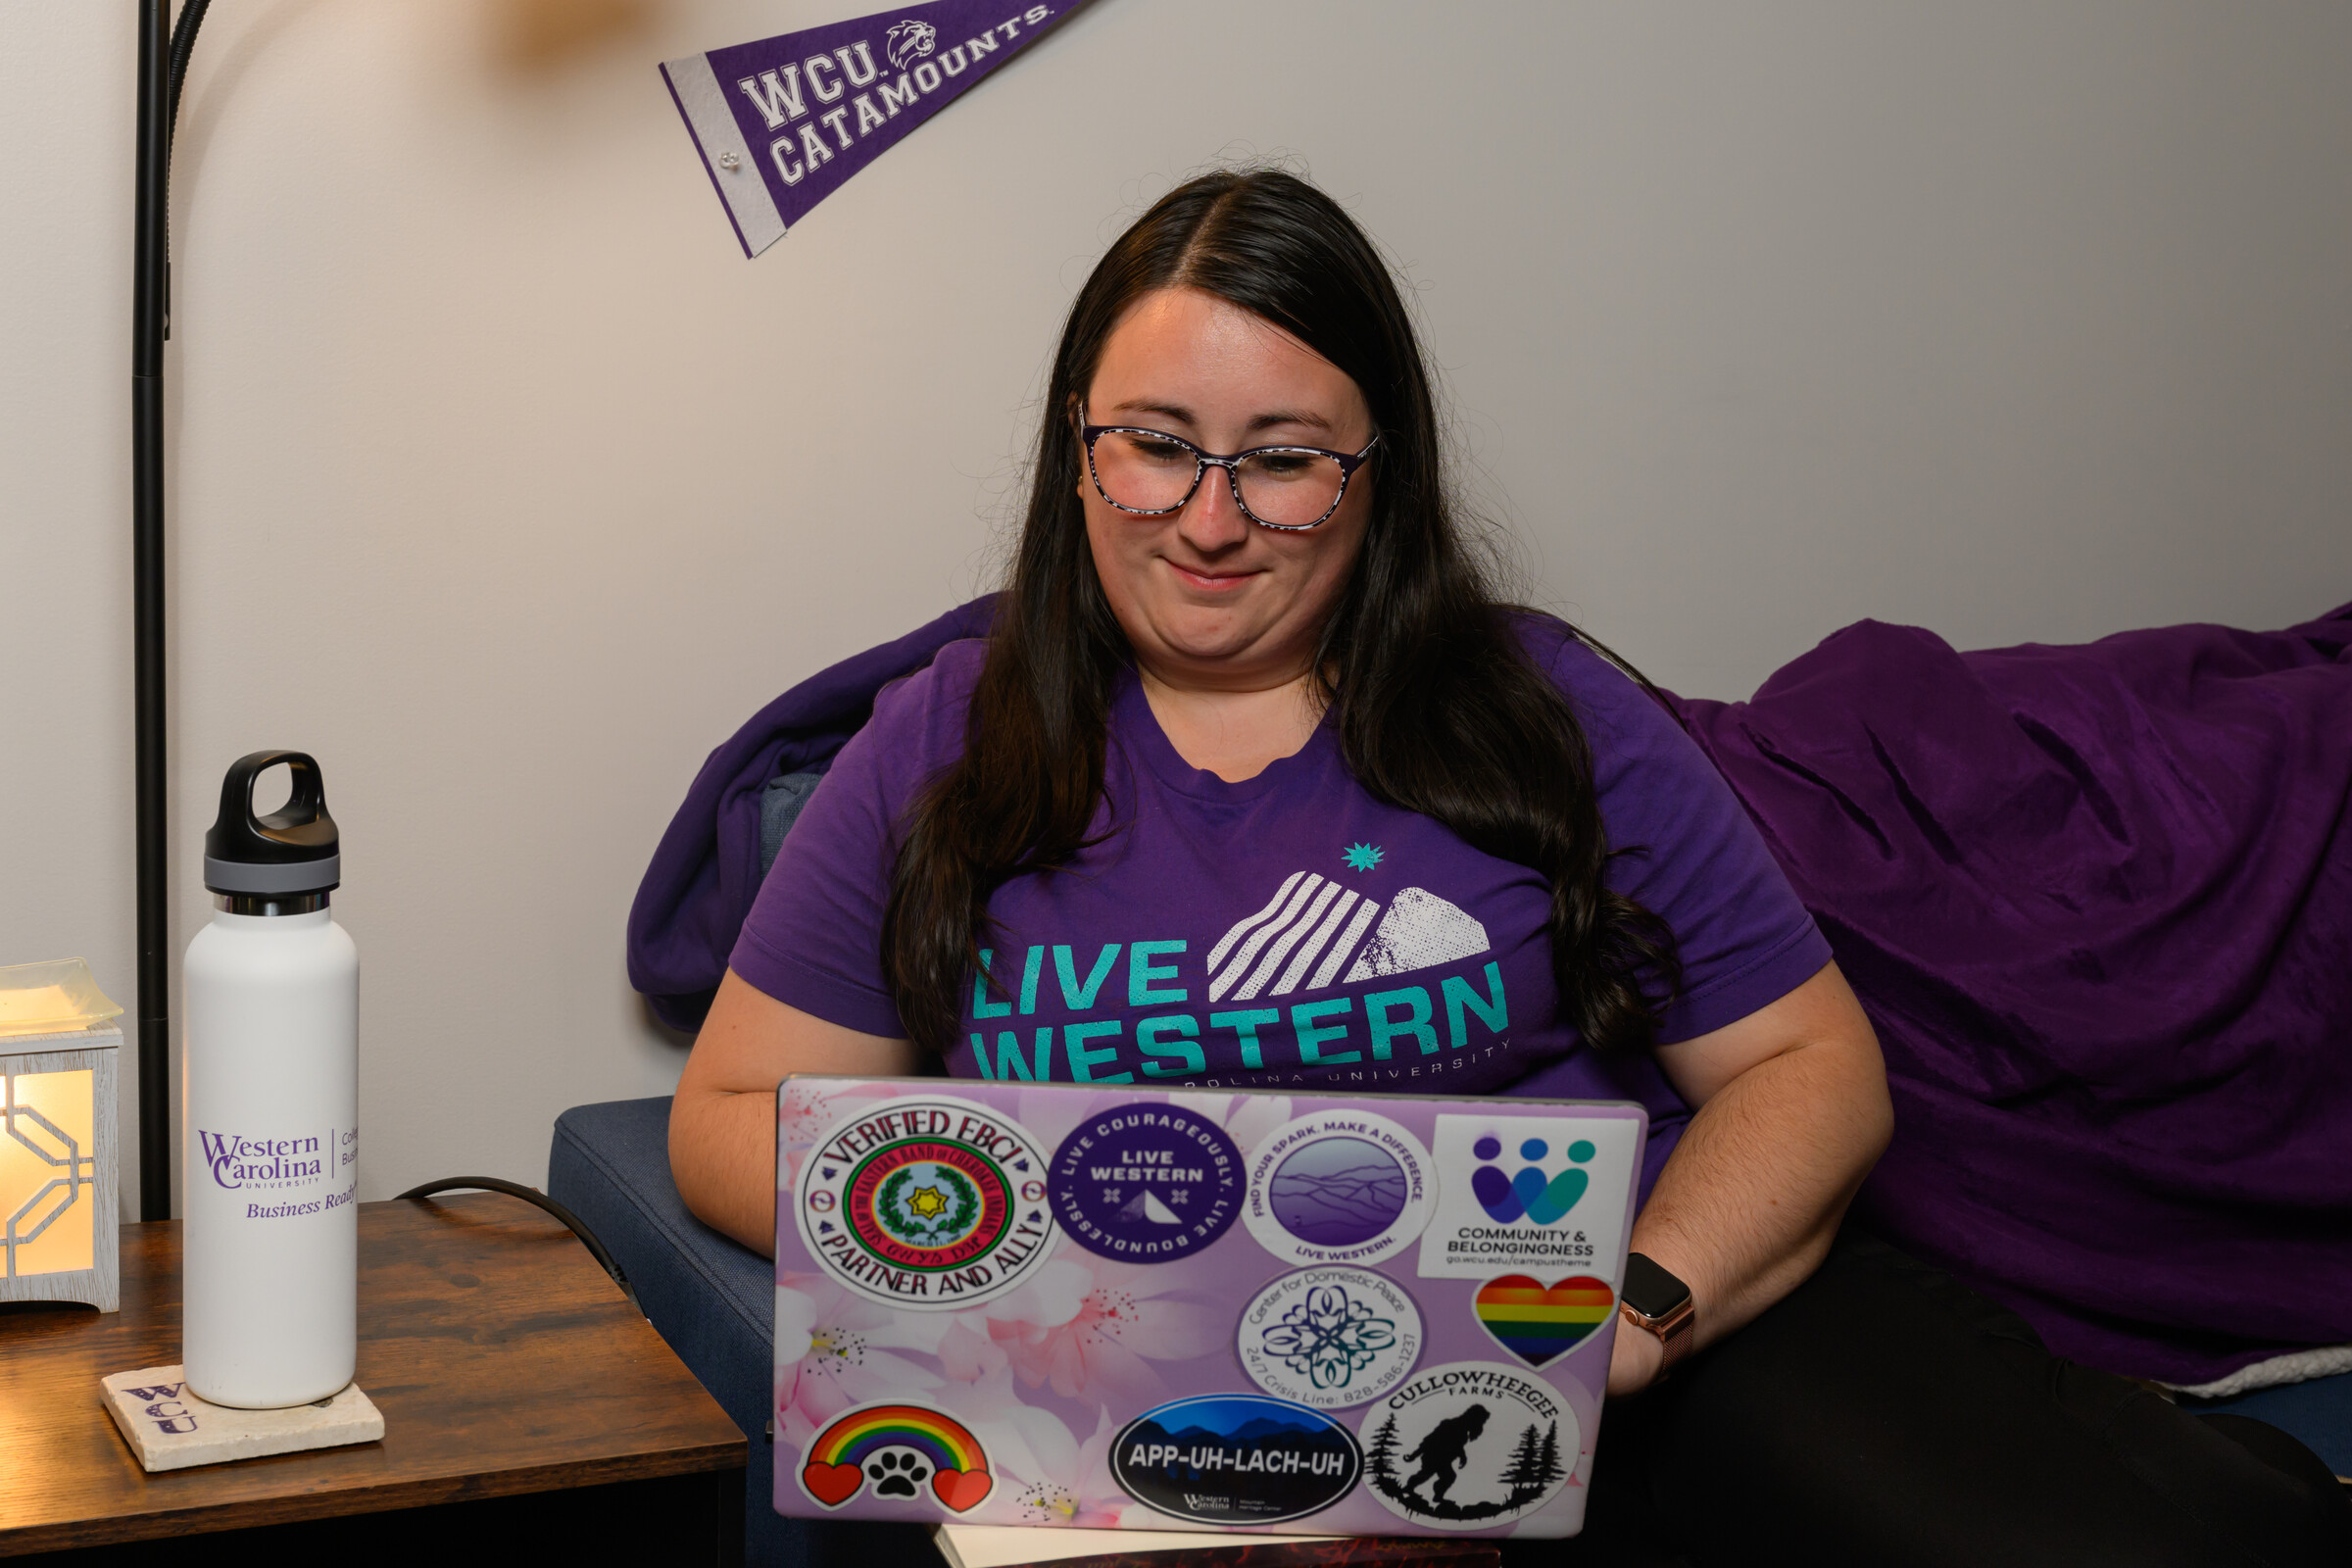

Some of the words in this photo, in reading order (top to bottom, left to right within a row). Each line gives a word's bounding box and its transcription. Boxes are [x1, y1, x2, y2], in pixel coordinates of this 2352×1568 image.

[770, 4, 1049, 186] CATAMOUNTS
[973, 939, 1188, 1020] LIVE
[969, 960, 1509, 1085] WESTERN
[1328, 1038, 1510, 1081] UNIVERSITY
[824, 1110, 950, 1165] VERIFIED
[956, 1116, 1023, 1164] EBCI
[1324, 1121, 1368, 1134] MAKE
[1369, 1128, 1380, 1138] A
[198, 1129, 319, 1170] Western
[900, 1145, 934, 1163] BAND
[1061, 1136, 1094, 1175] LIVE
[1122, 1151, 1174, 1164] LIVE
[214, 1154, 321, 1189] Carolina
[246, 1177, 319, 1189] UNIVERSITY
[1091, 1167, 1203, 1182] WESTERN
[1251, 1153, 1274, 1188] YOUR
[246, 1201, 321, 1218] Business
[1194, 1200, 1229, 1237] LIVE
[1250, 1187, 1264, 1218] FIND
[1447, 1241, 1593, 1256] BELONGINGNESS
[1458, 1227, 1570, 1242] COMMUNITY
[1574, 1231, 1587, 1243] &
[821, 1234, 928, 1296] PARTNER
[938, 1265, 993, 1296] AND
[995, 1224, 1044, 1274] ALLY
[1296, 1245, 1325, 1260] LIVE
[1446, 1255, 1592, 1267] go.wcu.edu/campustheme
[1249, 1289, 1283, 1325] Center
[1282, 1278, 1301, 1294] for
[1304, 1271, 1373, 1288] Domestic
[1373, 1281, 1405, 1313] Peace
[1247, 1347, 1268, 1374] 24/7
[1264, 1375, 1298, 1399] Crisis
[1302, 1394, 1339, 1404] Line:
[1344, 1334, 1415, 1403] 828-586-1237
[1389, 1371, 1559, 1420] CULLOWHEEGEE
[1448, 1386, 1505, 1399] FARMS
[1128, 1444, 1345, 1476] APP-UH-LACH-UH
[1184, 1494, 1229, 1504] Western
